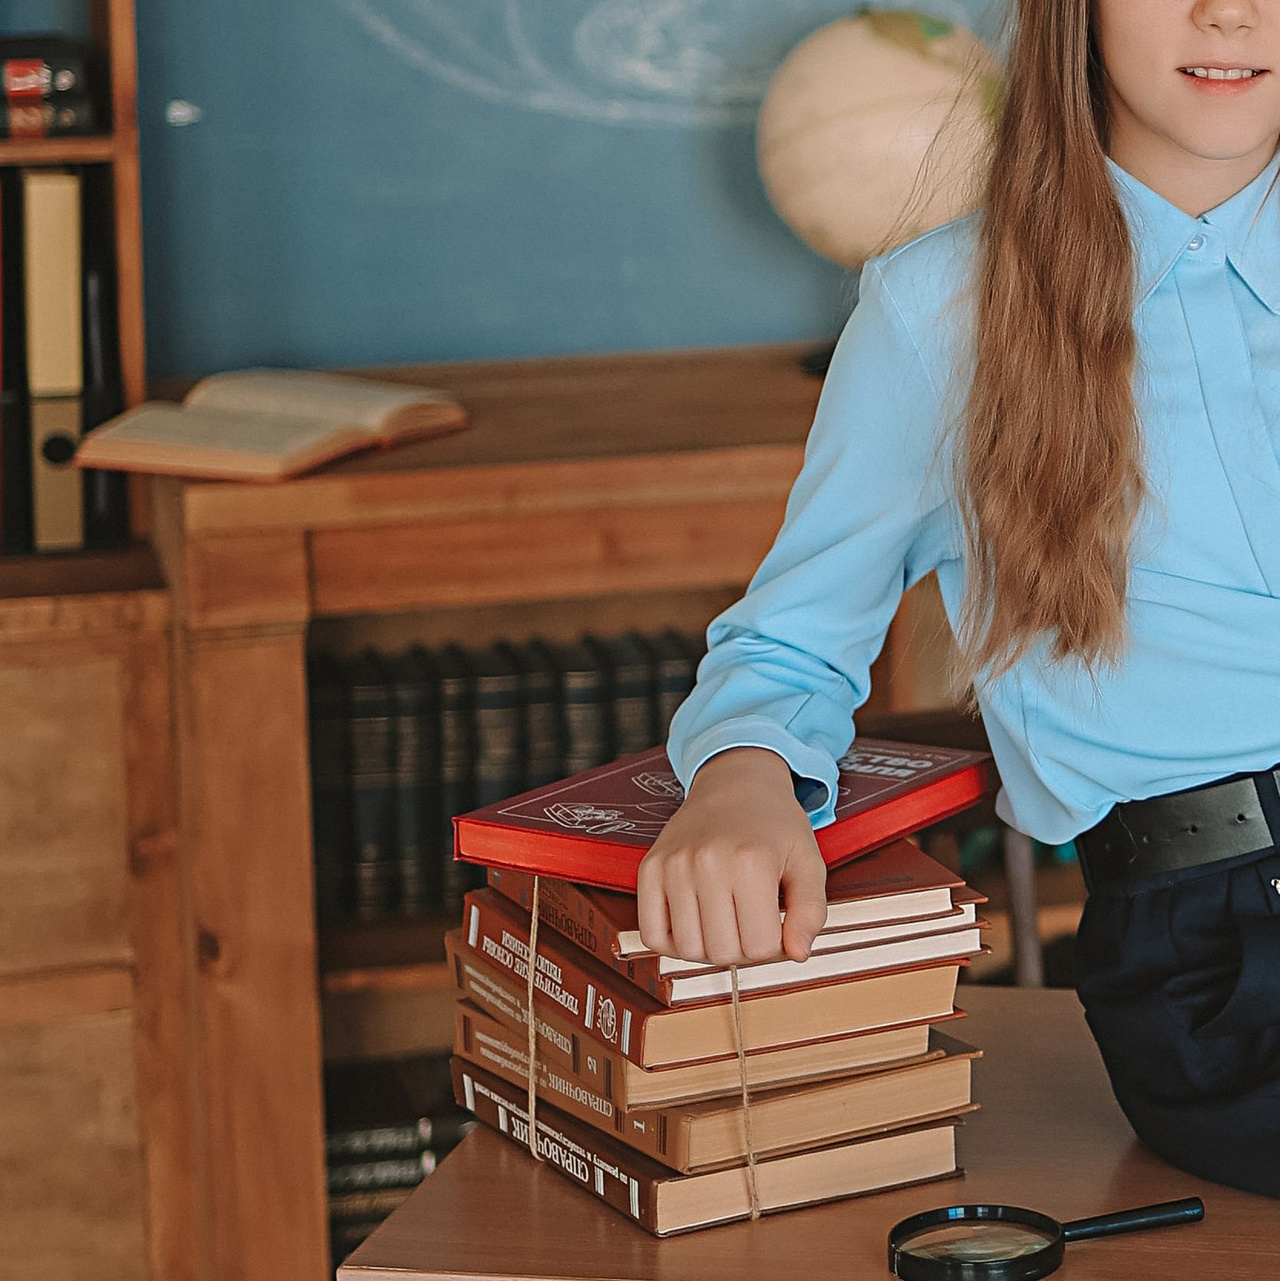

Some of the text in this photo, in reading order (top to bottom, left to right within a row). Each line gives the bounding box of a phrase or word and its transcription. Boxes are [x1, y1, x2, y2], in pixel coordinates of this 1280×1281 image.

[482, 936, 513, 969] ОСНОВЫ
[502, 930, 562, 984] ТЕПЛОХНИКИ
[514, 959, 579, 1015] ТЕОРЕТИЧЕКИЕ
[548, 1073, 612, 1117] СПРАВОЧНИК
[511, 1117, 589, 1183] СПРАВОЧИК
